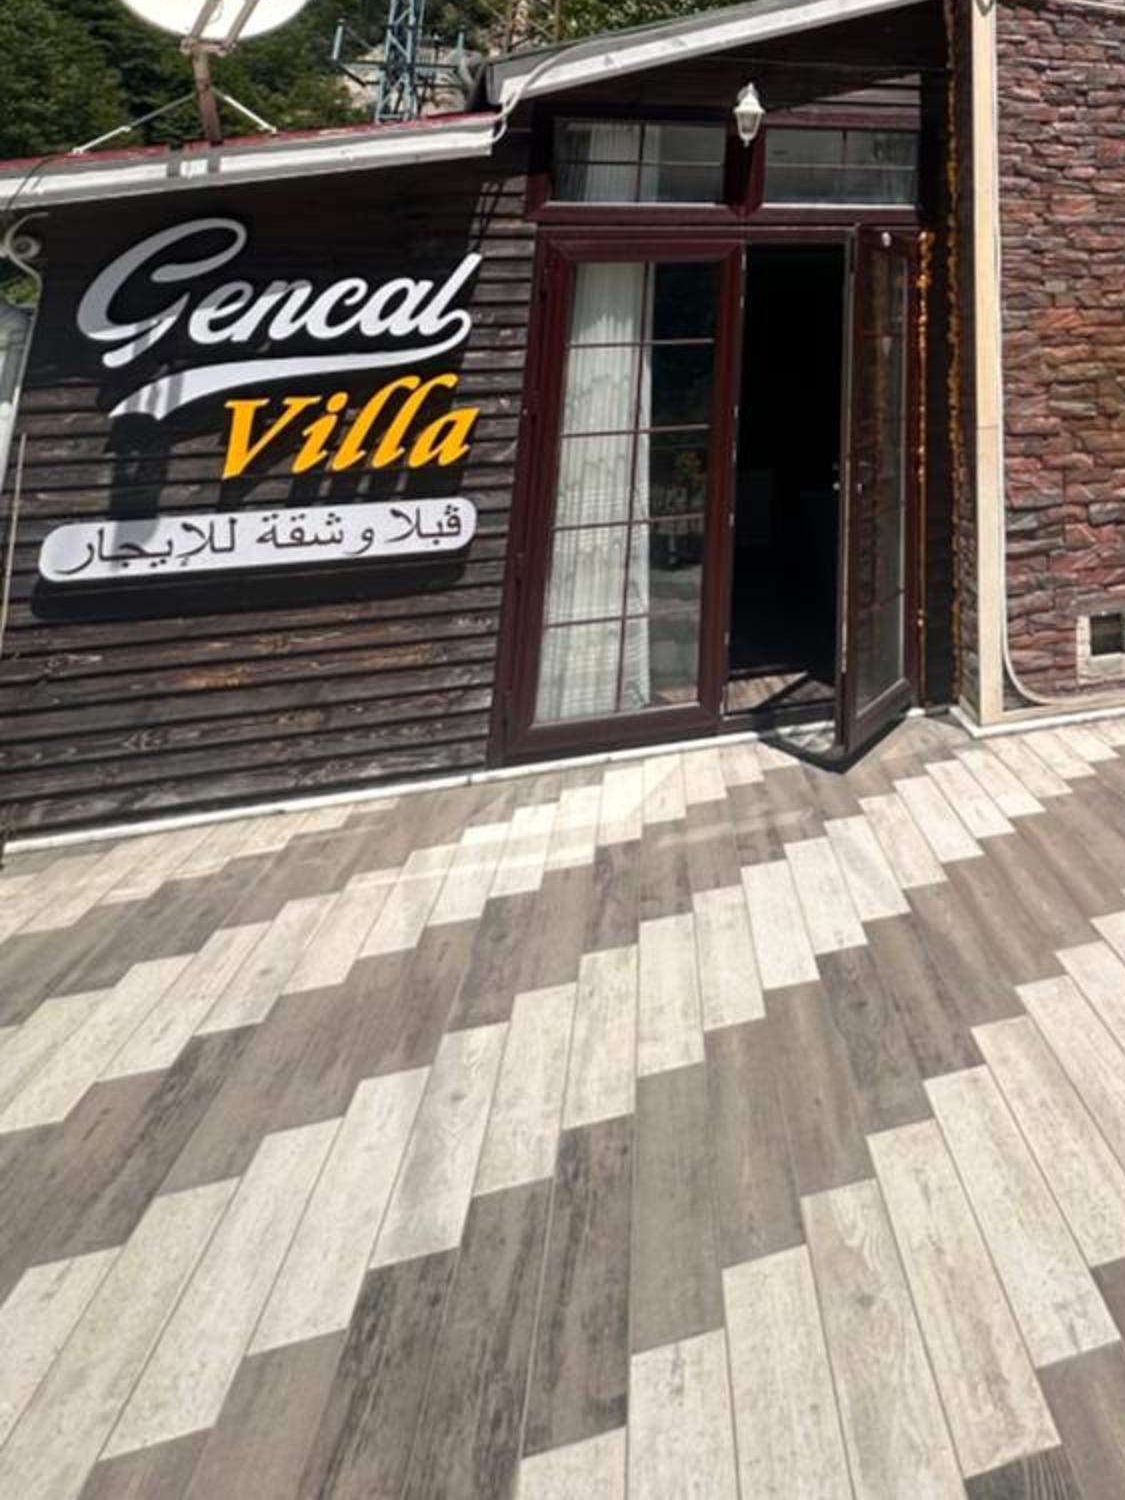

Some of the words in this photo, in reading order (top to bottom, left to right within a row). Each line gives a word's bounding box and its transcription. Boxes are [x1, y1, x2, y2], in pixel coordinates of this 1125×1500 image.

[77, 218, 482, 368] Gencal
[223, 373, 481, 480] Villa
[53, 516, 237, 575] للإيجار
